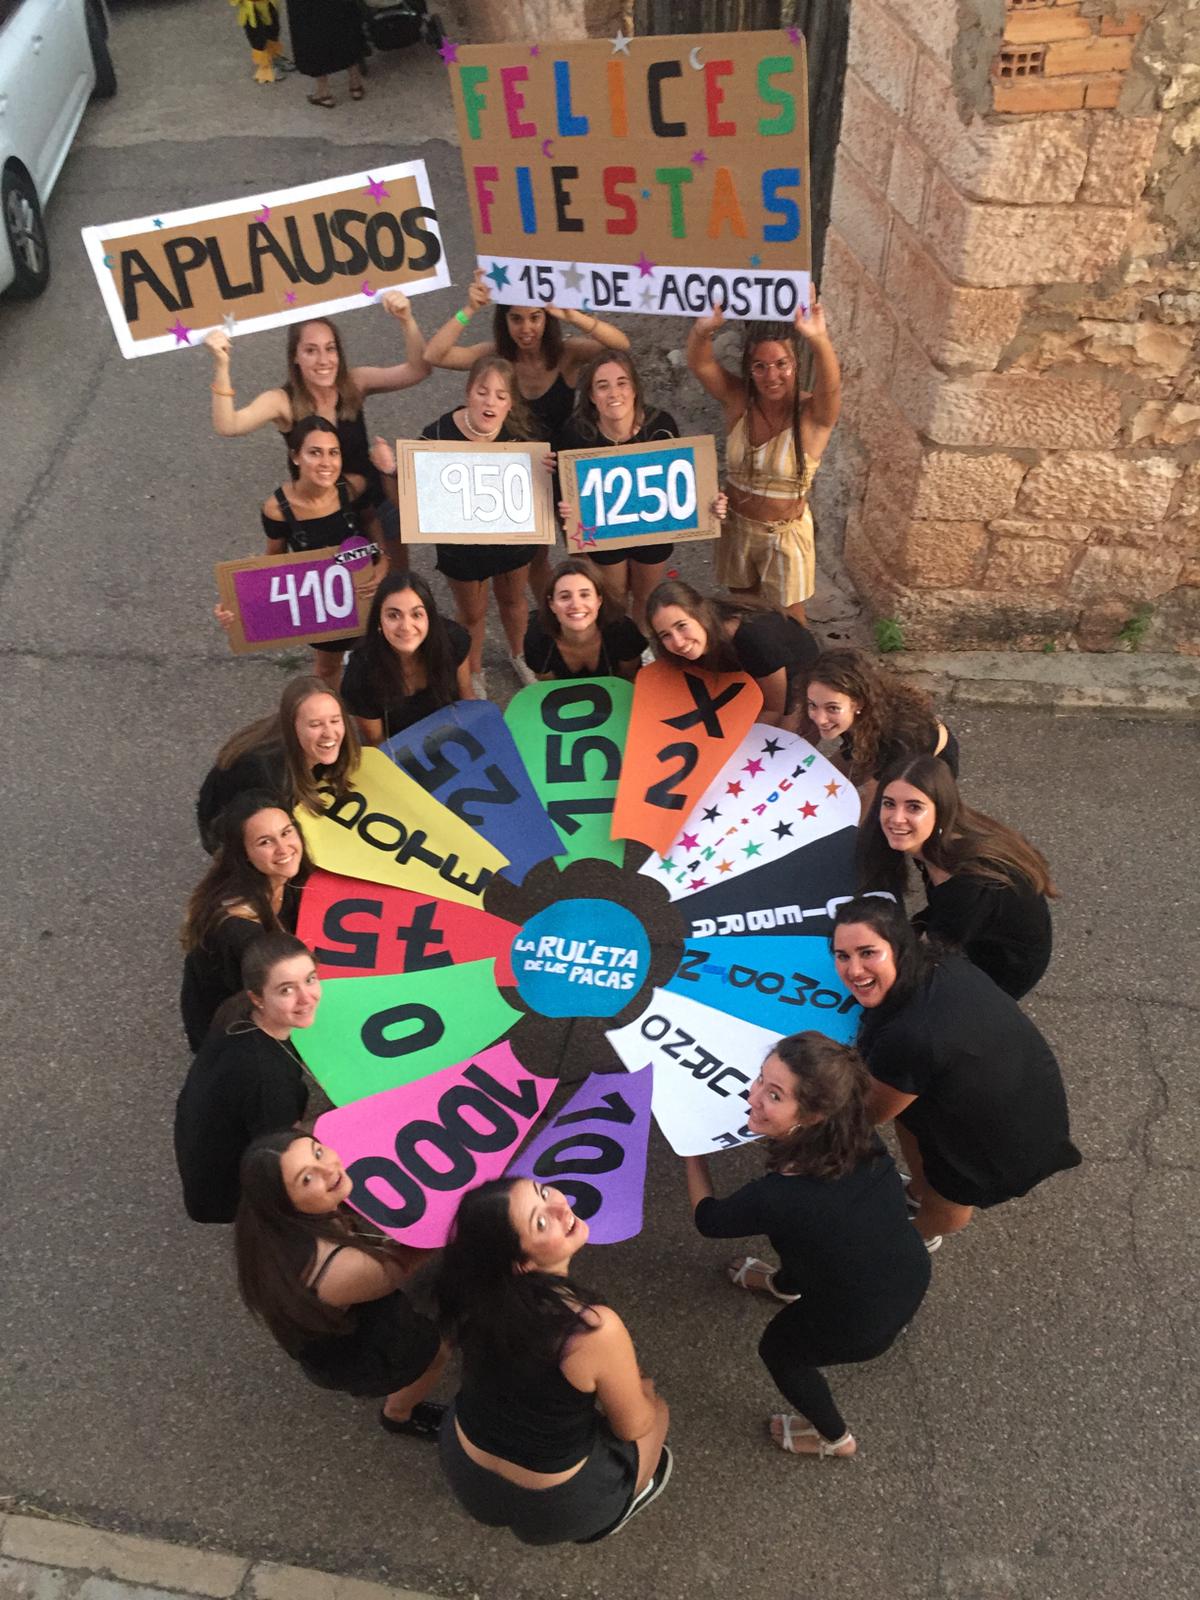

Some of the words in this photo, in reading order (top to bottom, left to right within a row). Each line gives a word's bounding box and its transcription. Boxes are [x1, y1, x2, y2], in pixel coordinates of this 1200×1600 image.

[459, 55, 797, 139] FELICES
[473, 165, 801, 243] FIESTAS
[120, 206, 442, 323] APLAUSOS
[519, 265, 555, 302] 15
[591, 270, 632, 307] DE
[658, 273, 798, 316] AGOSTO
[440, 462, 532, 524] 950
[579, 458, 698, 526] 1250
[268, 565, 354, 626] 410
[540, 683, 622, 836] 150
[313, 897, 455, 973] 75
[514, 938, 536, 952] LA
[523, 959, 544, 972] DE
[567, 965, 636, 990] PACAS
[360, 1002, 445, 1059] 0
[345, 1063, 540, 1229] 1000
